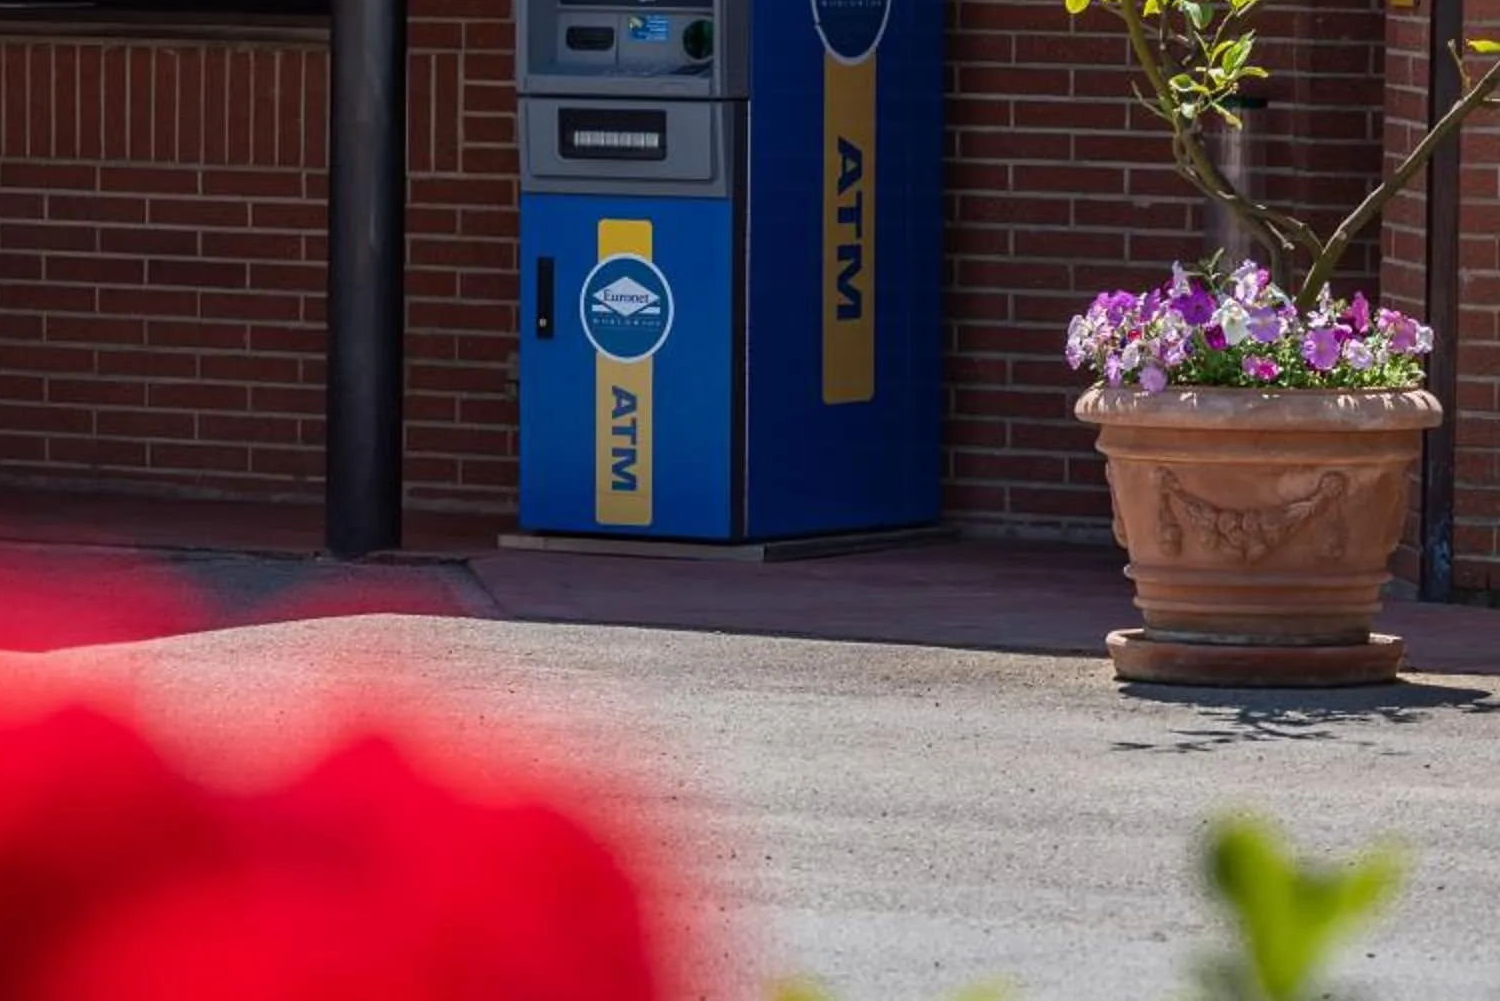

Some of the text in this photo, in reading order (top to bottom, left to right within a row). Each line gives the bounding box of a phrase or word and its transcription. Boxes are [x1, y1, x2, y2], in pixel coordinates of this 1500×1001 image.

[836, 135, 863, 321] ATM
[603, 289, 650, 303] Euronet
[610, 384, 637, 492] ATM
